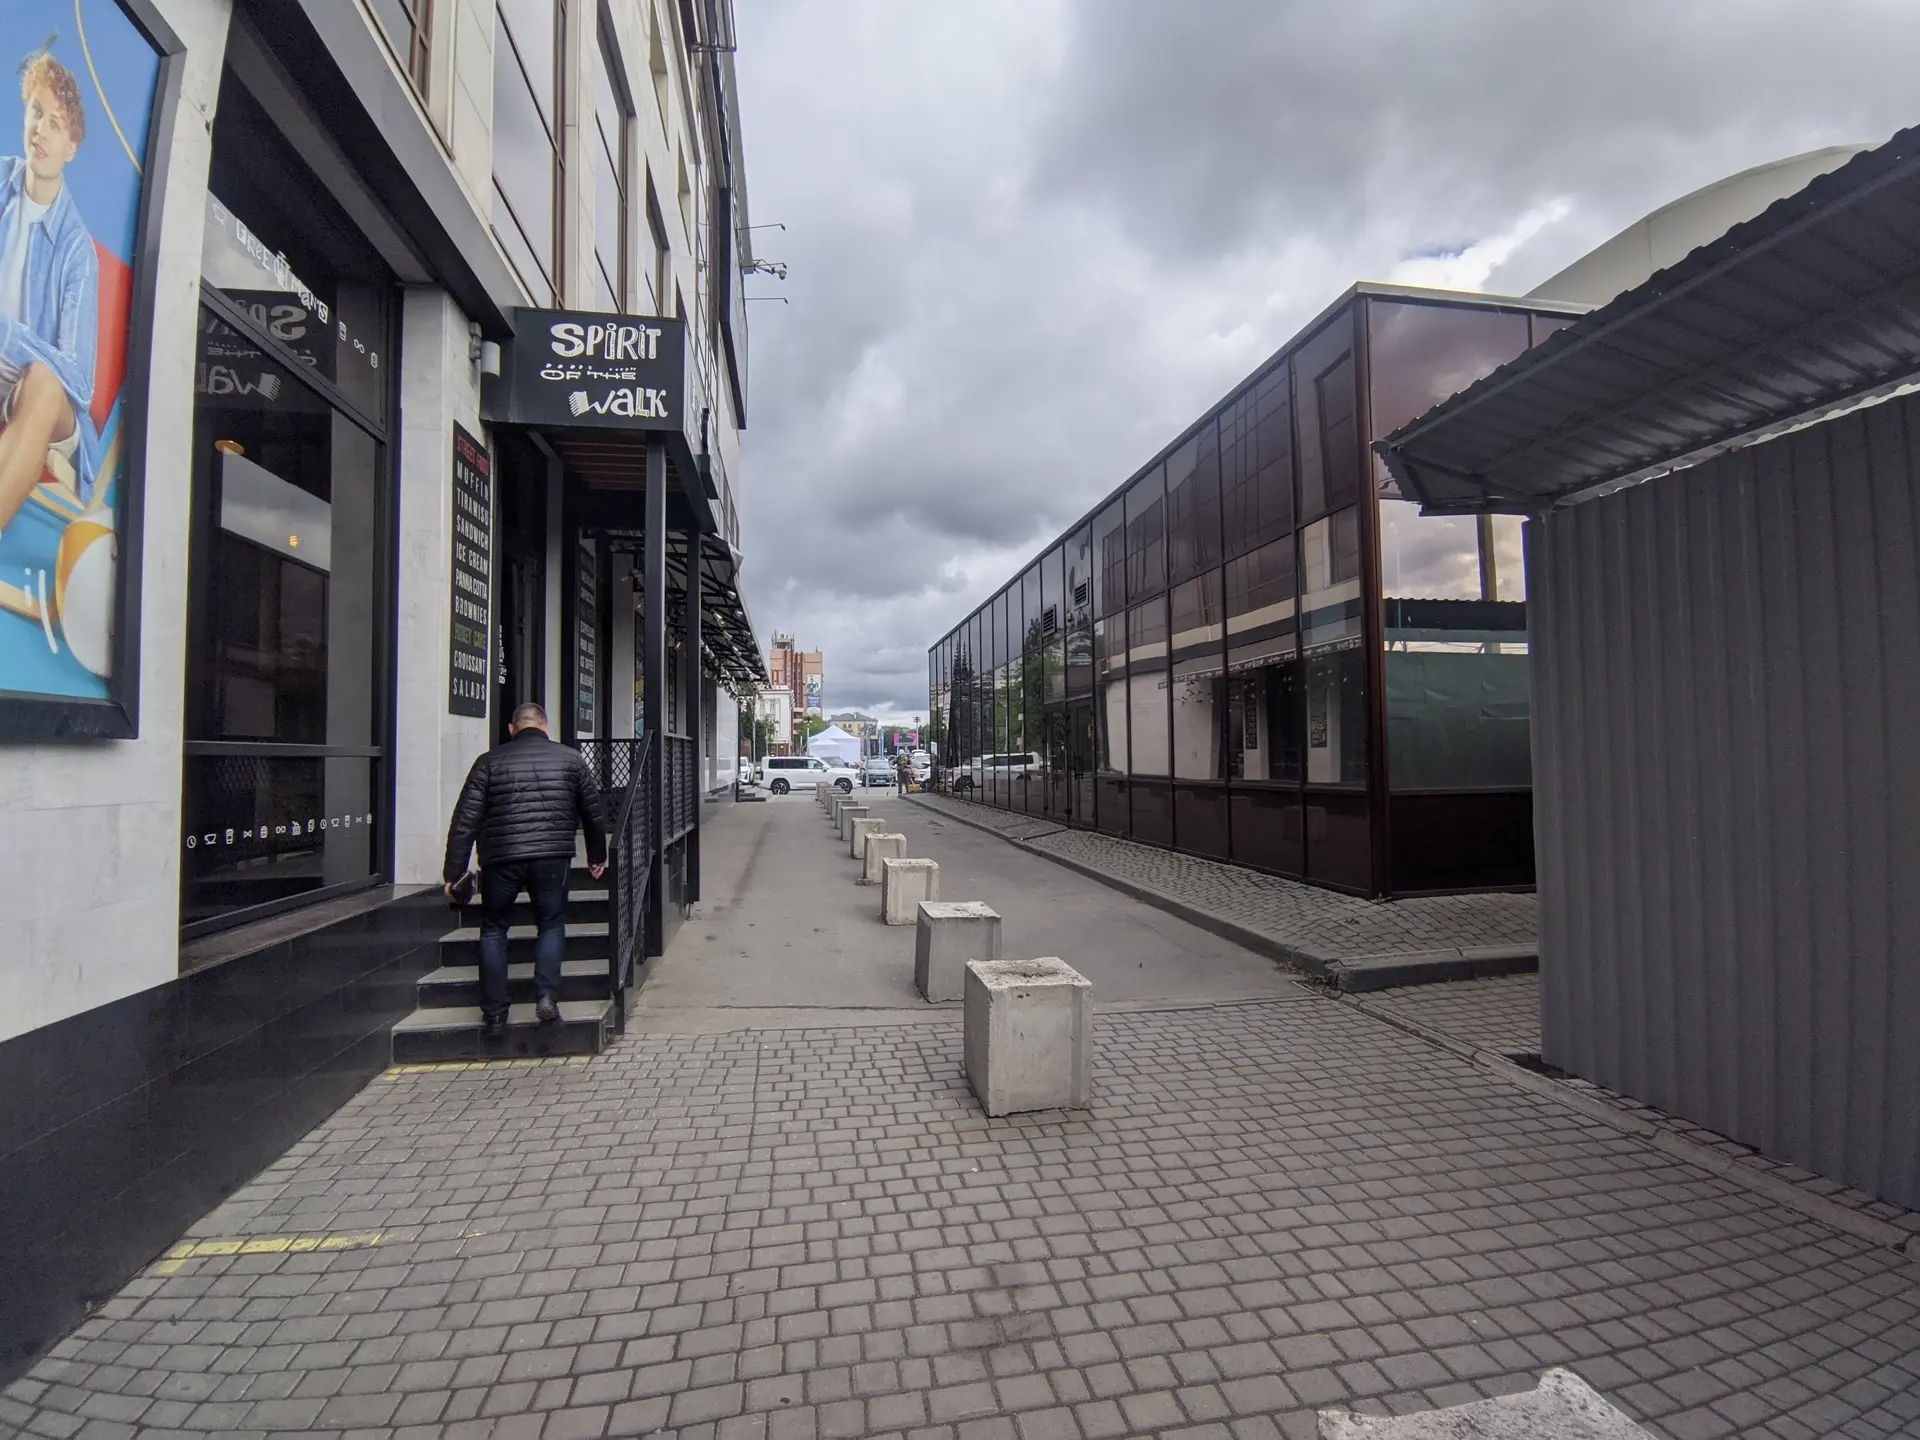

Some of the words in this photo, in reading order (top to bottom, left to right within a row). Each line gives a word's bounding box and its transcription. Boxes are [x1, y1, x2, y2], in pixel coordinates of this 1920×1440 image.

[587, 367, 636, 381] THE
[456, 460, 489, 501] MUFFIN
[456, 487, 489, 526] TIRAMISU
[456, 514, 489, 551] SANDWICH
[456, 541, 467, 563] ICE
[468, 549, 488, 576] CREAM
[455, 568, 472, 593] PANNA
[473, 578, 487, 600] COTTA
[455, 595, 487, 626] BROWNIES
[453, 650, 485, 676] CROISSANT
[453, 677, 485, 701] SALADS
